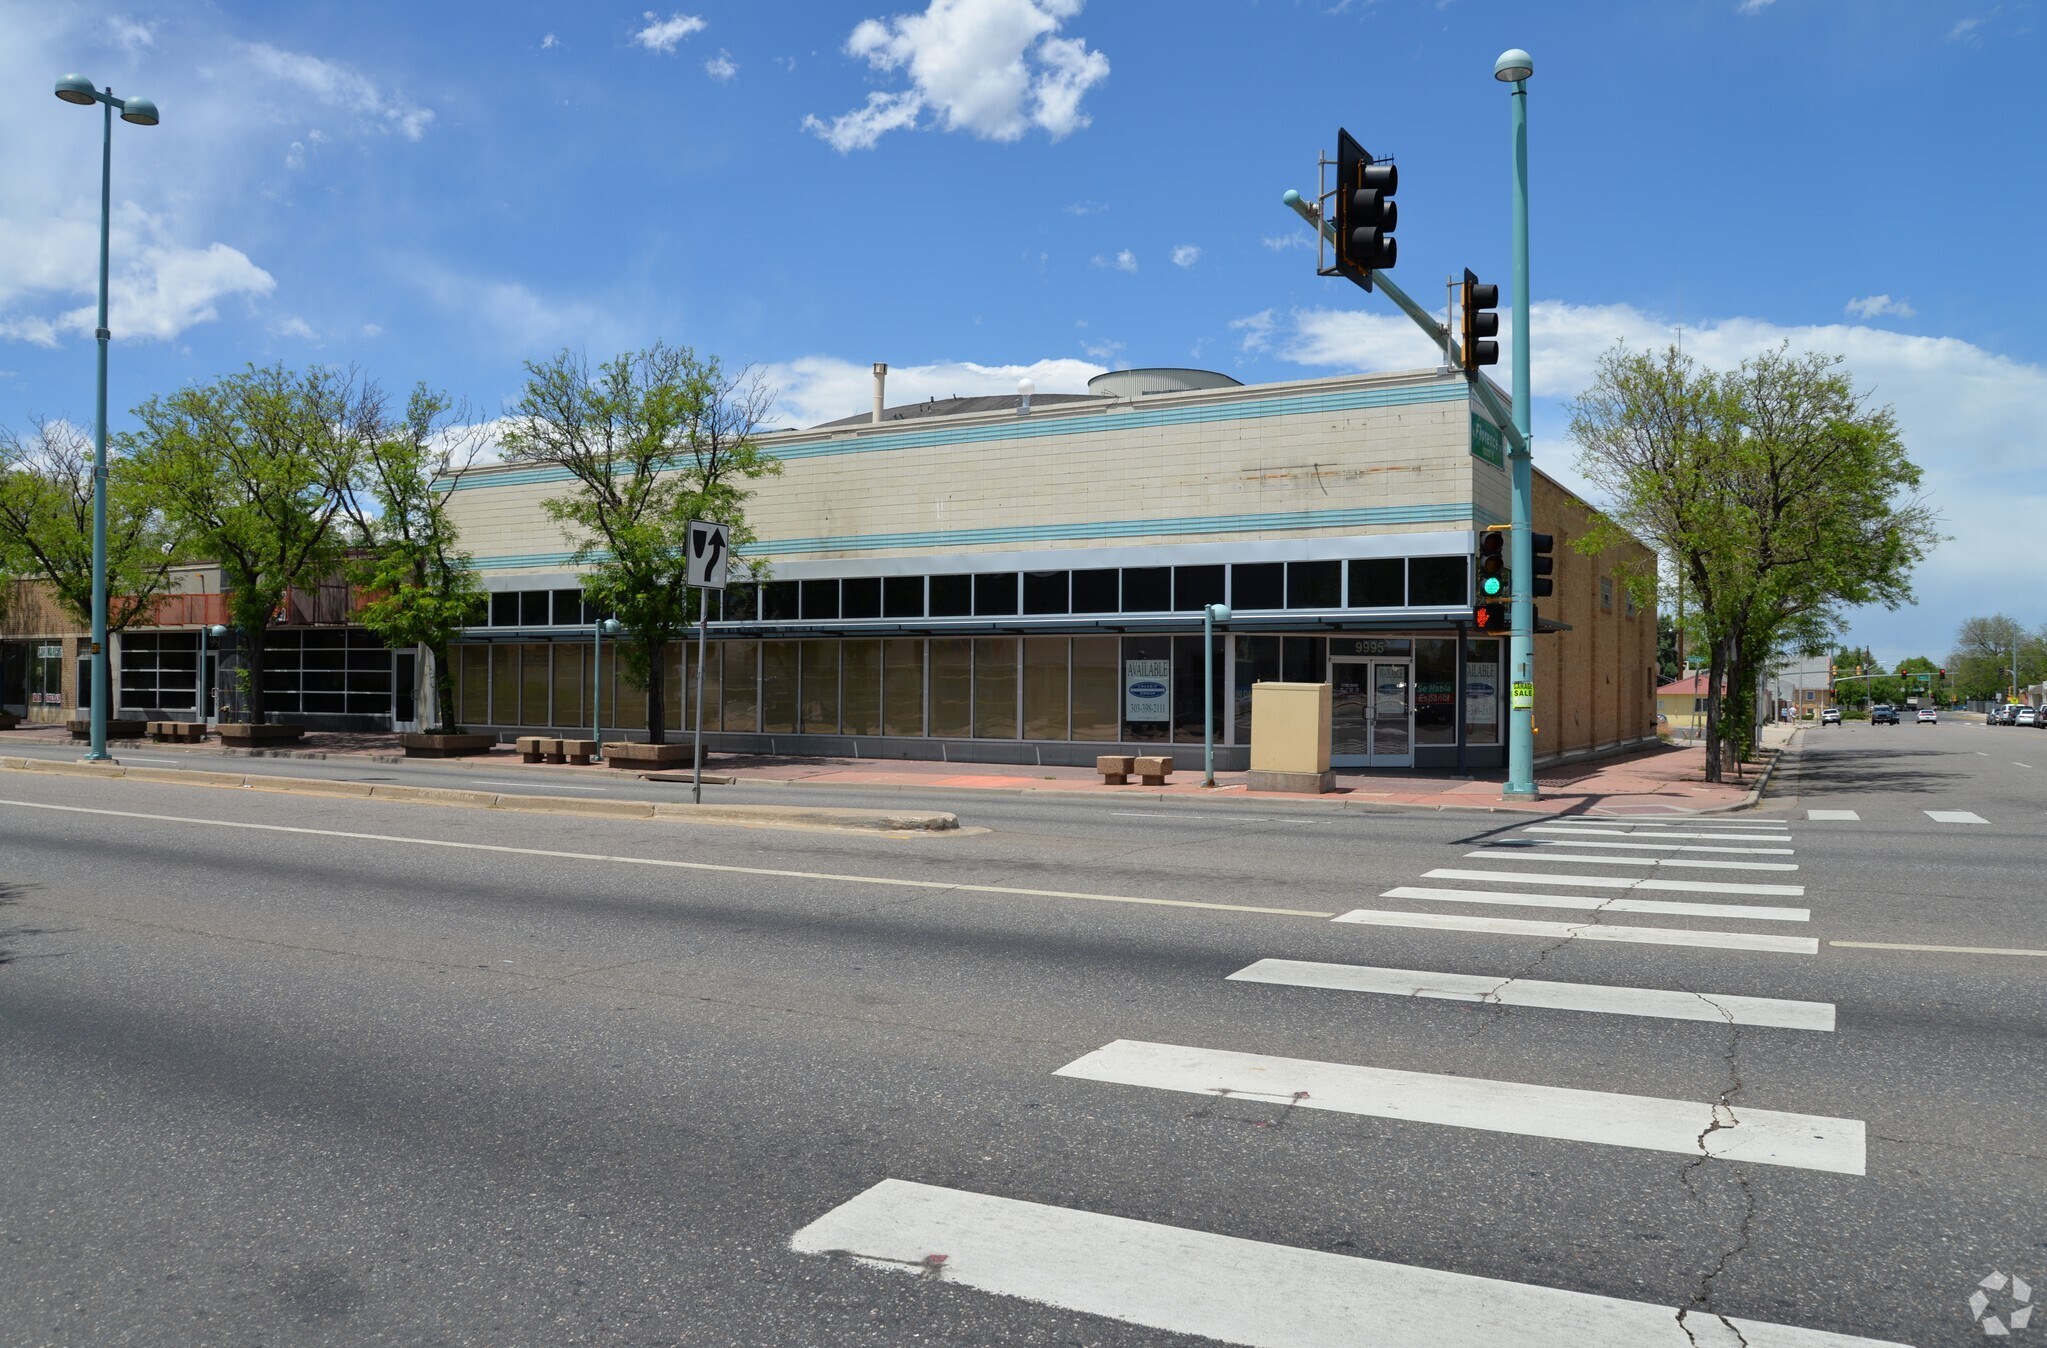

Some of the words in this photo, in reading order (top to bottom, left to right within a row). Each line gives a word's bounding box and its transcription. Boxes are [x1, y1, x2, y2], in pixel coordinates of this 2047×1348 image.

[1355, 642, 1384, 653] 9995
[1128, 662, 1168, 677] AVAILABLE
[1466, 664, 1495, 678] AILABLE
[1417, 684, 1427, 693] Se
[1429, 684, 1451, 693] Habla
